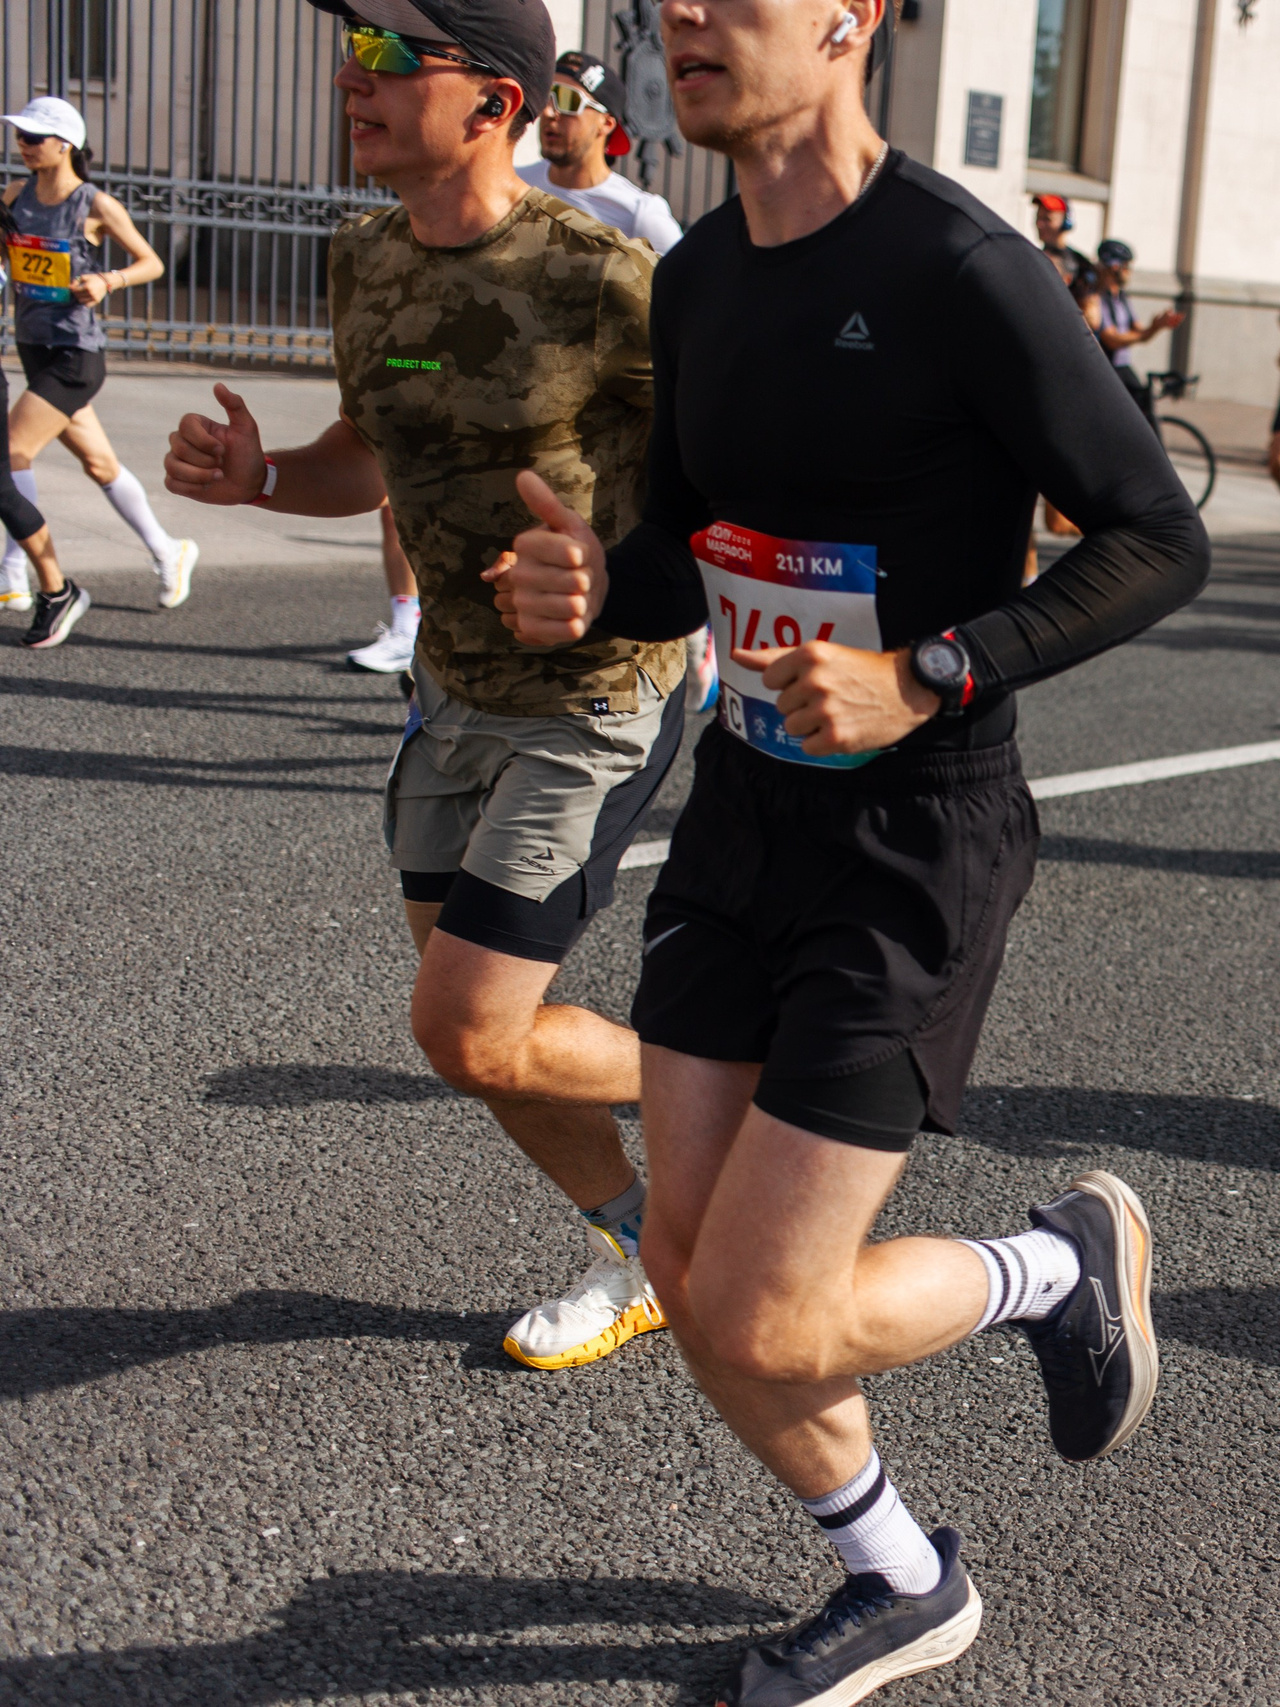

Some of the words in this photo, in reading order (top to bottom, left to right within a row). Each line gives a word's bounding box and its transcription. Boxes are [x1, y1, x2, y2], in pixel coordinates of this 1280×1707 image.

[22, 252, 54, 276] 272
[386, 357, 420, 369] PROJECT
[421, 360, 442, 371] ROCK
[705, 537, 752, 562] МАРАФОН
[775, 553, 805, 577] 21,1
